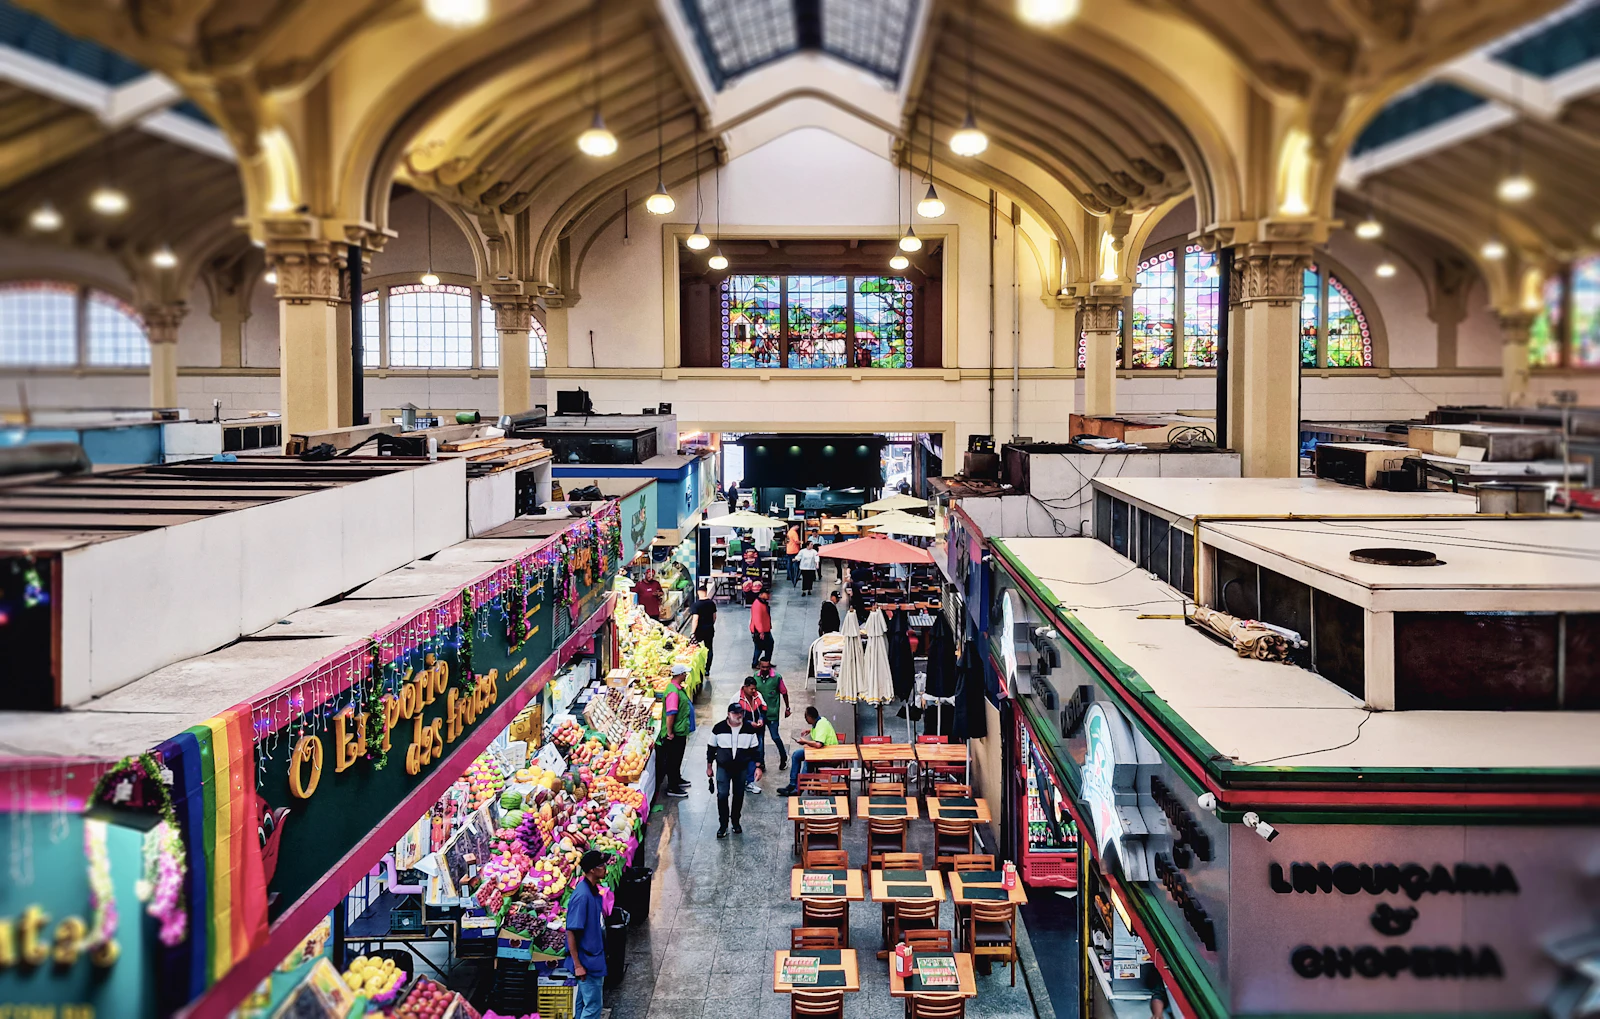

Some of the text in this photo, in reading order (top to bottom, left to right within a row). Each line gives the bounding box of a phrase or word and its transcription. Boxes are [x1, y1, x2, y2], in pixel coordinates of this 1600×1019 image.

[406, 668, 498, 775] das frutas
[289, 735, 323, 799] O
